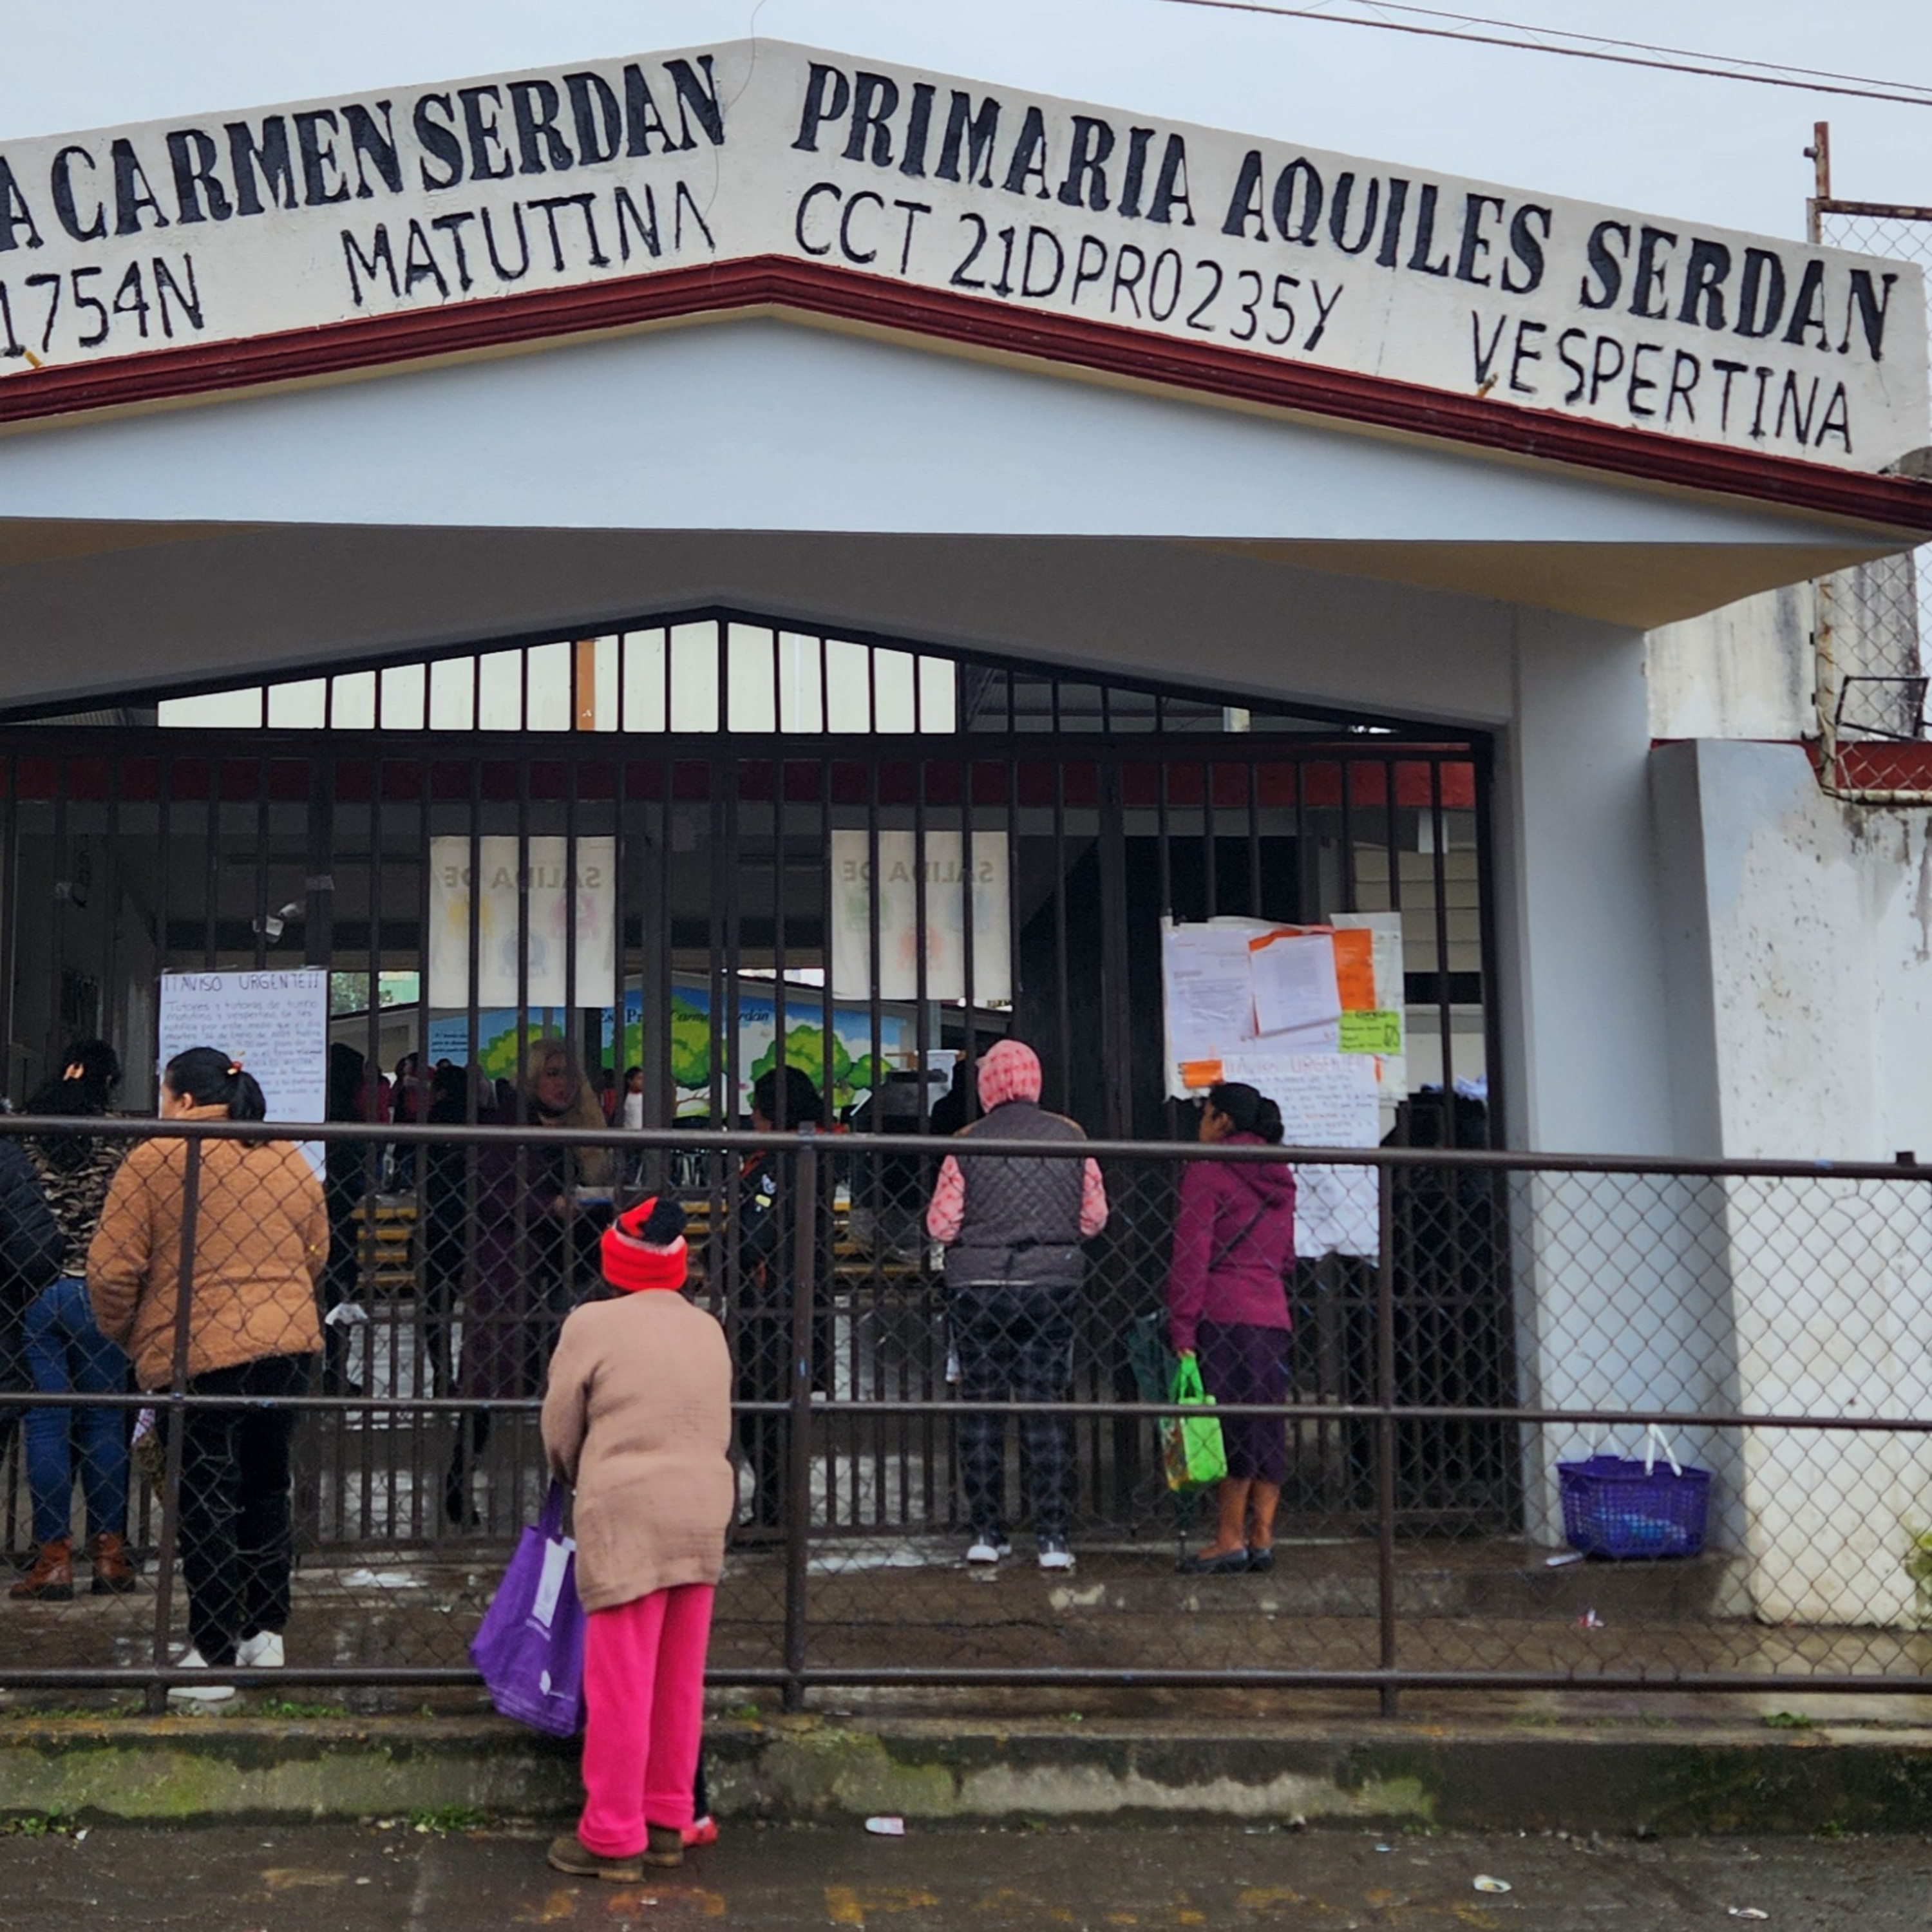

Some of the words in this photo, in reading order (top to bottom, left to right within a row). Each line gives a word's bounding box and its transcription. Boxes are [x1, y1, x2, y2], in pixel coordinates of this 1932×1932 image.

[52, 100, 403, 242] CARMEN
[413, 55, 724, 191] SERDAN
[791, 62, 1195, 225] PRIMARIA
[1222, 150, 1551, 294] AQUILES
[1580, 221, 1898, 362] SERDAN
[0, 254, 204, 357] 1754N
[341, 181, 714, 306] MATUTINA
[796, 183, 931, 274] CCT
[950, 213, 1342, 350] 21DPR0235Y
[1473, 311, 1851, 453] VESPERTINA
